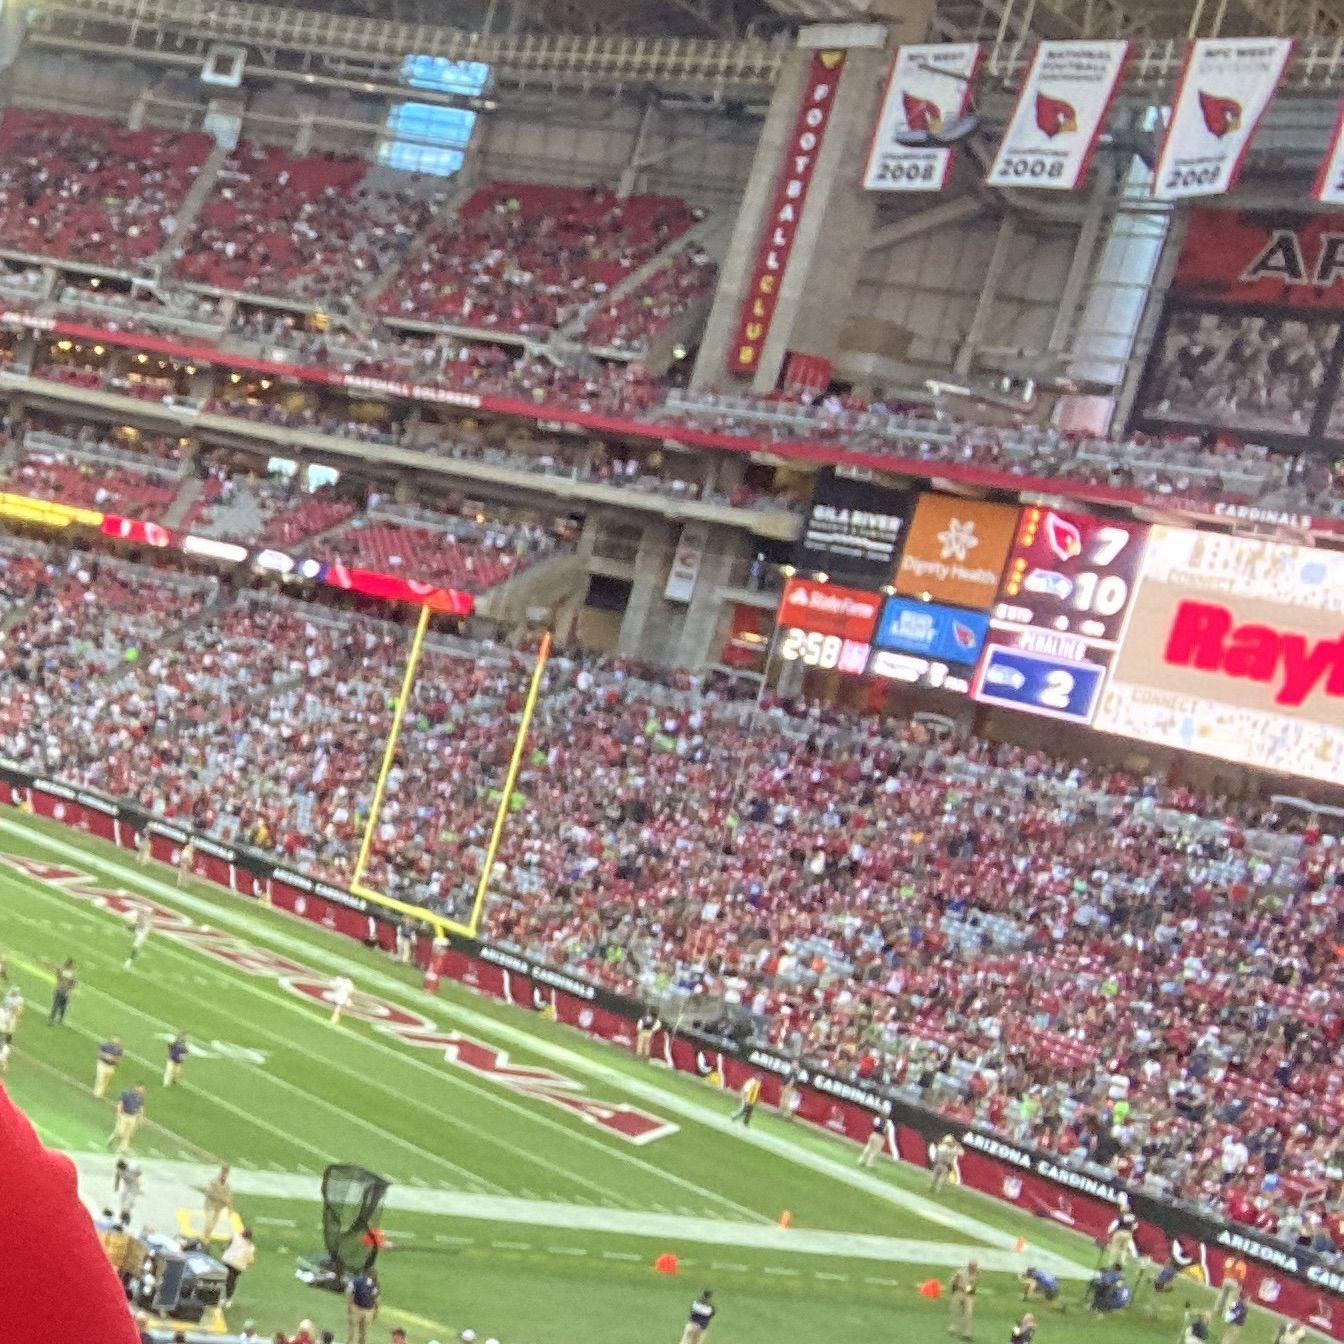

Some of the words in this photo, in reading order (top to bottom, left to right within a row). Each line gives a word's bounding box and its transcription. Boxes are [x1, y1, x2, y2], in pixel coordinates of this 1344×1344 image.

[1214, 502, 1313, 529] CARDINALS
[1088, 526, 1130, 566] 7
[1074, 571, 1128, 617] 10
[781, 627, 843, 669] 2:58
[1039, 670, 1075, 709] 2
[748, 1050, 809, 1083] ARIZOA
[813, 1074, 892, 1117] CARDINALS
[962, 1131, 1031, 1169] ARIZONA
[1037, 1159, 1129, 1209] CARDINALS
[1217, 1229, 1298, 1273] ARIZONA
